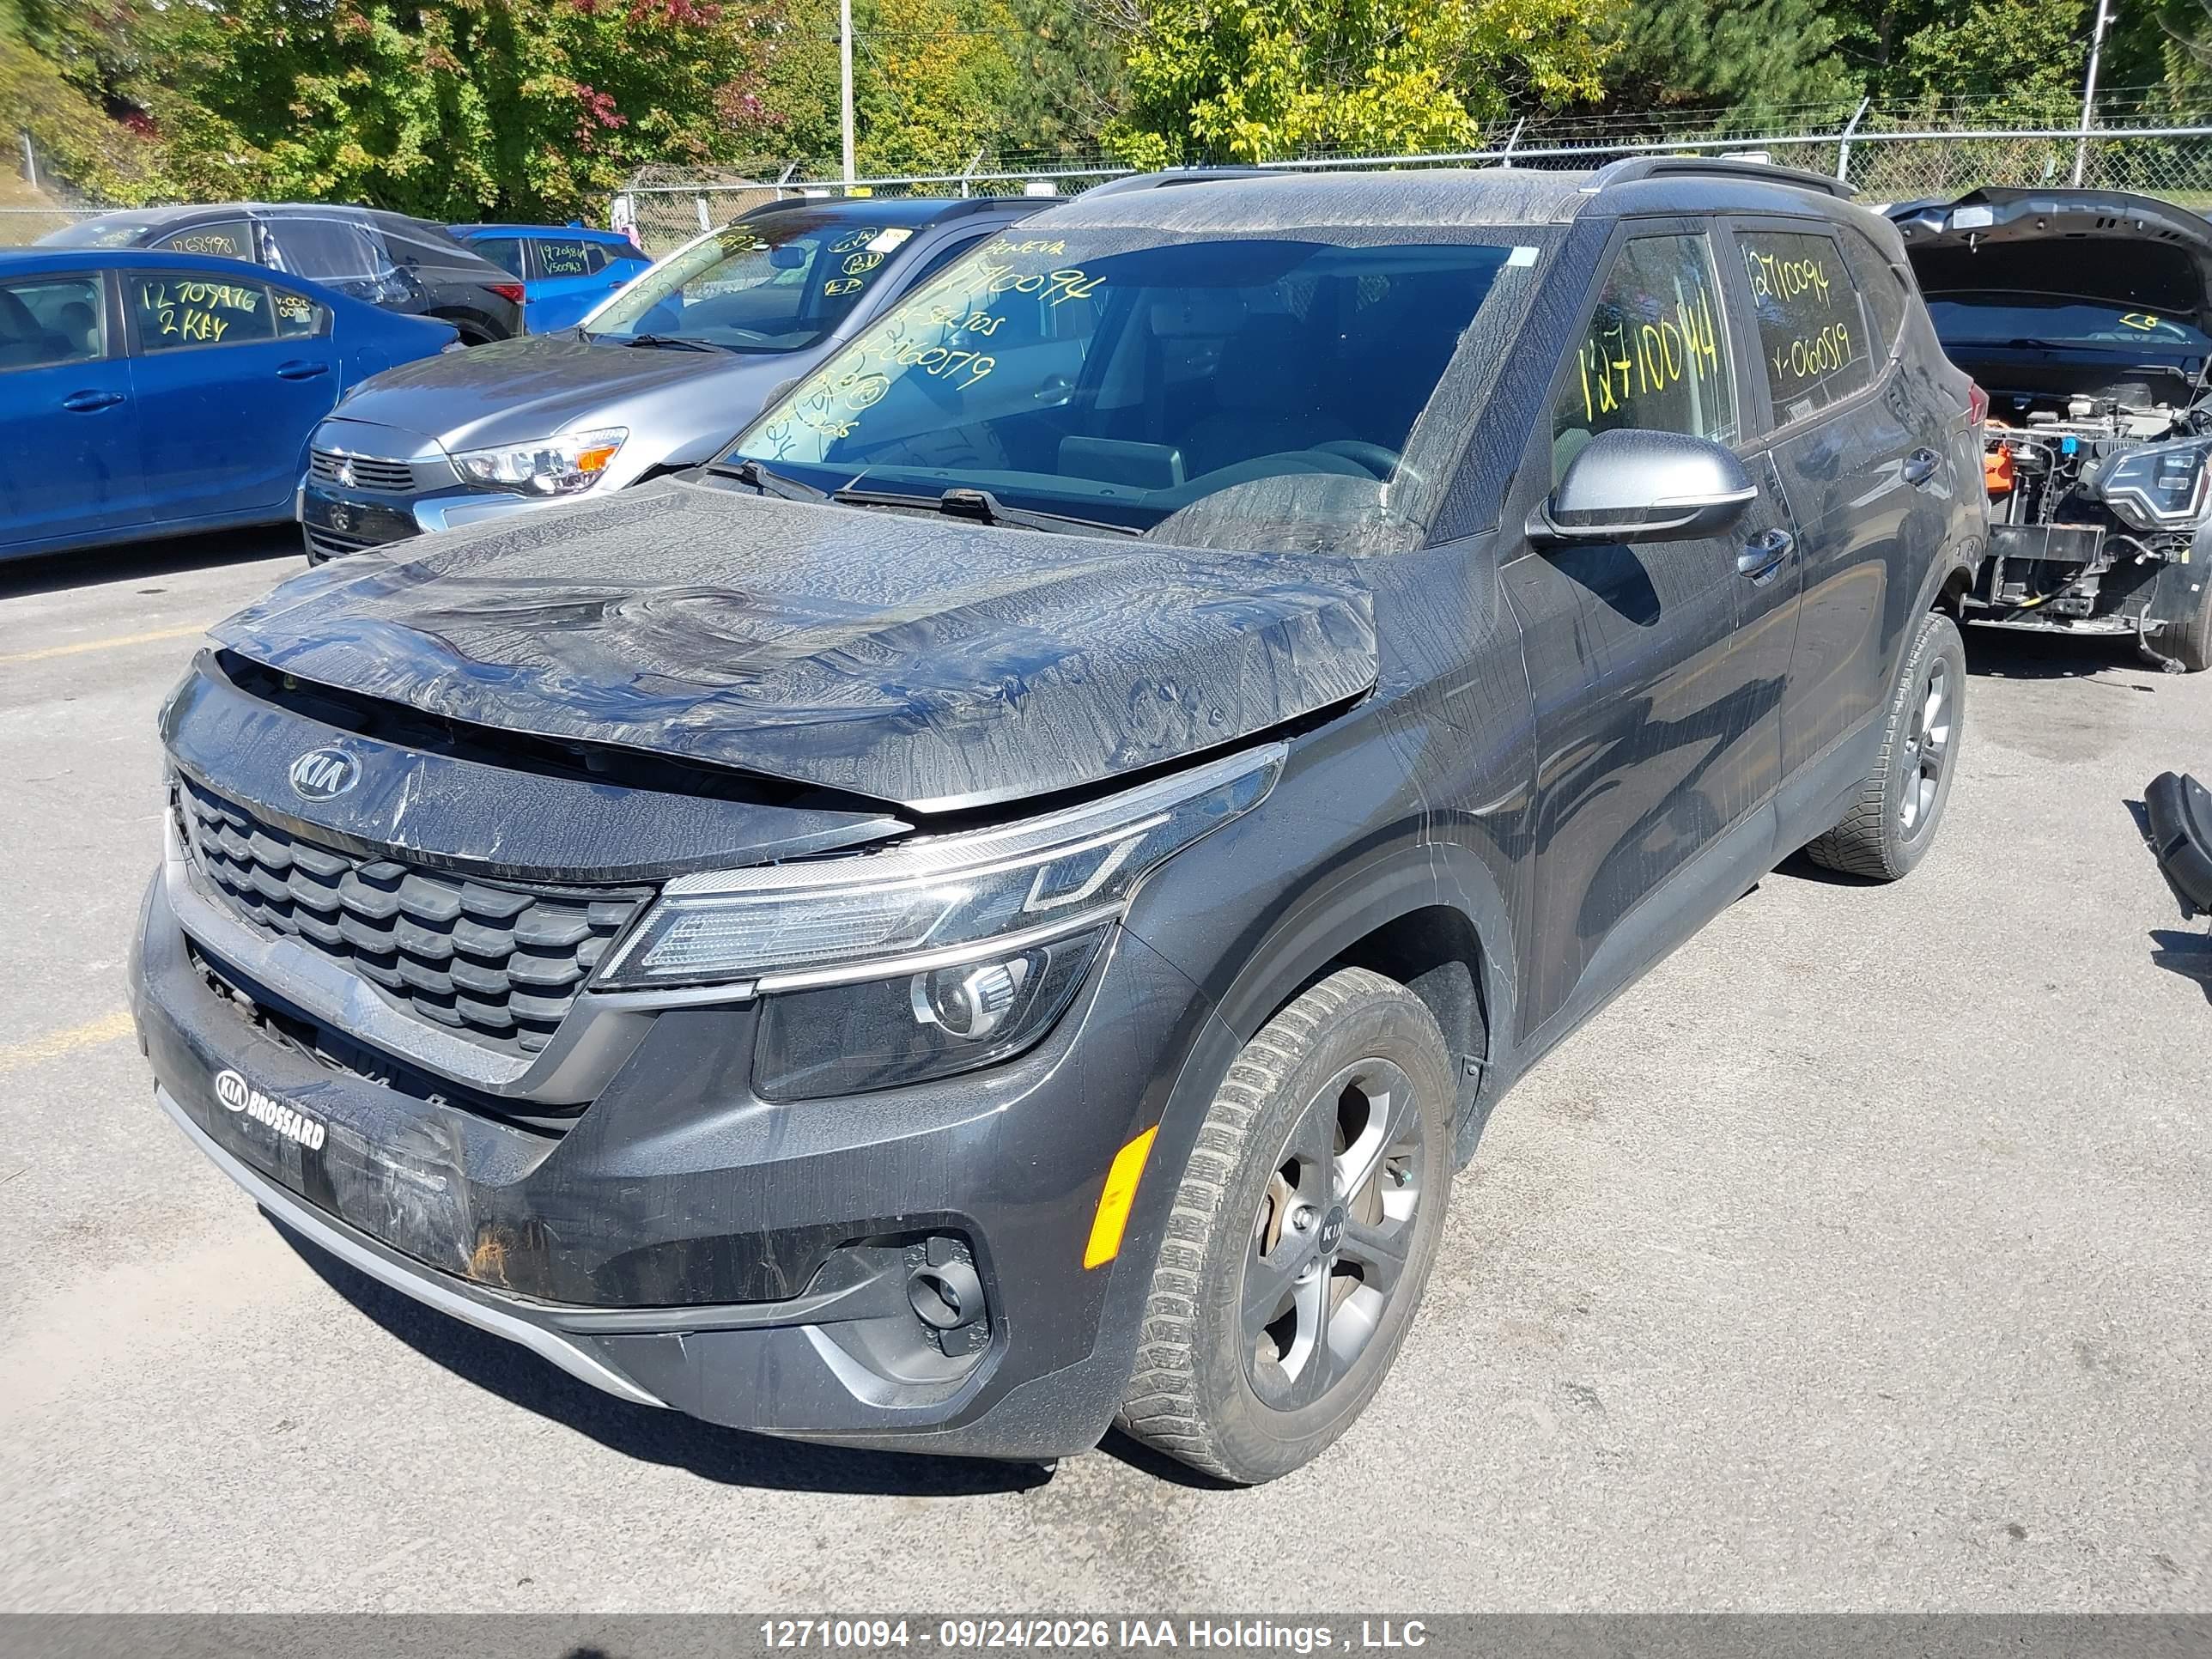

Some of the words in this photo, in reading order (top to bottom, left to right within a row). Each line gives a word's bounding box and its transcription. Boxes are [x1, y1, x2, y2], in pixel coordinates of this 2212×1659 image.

[1741, 245, 1830, 309] 12710094
[160, 309, 179, 335] 2
[294, 753, 345, 793] KIA
[220, 1075, 243, 1107] KIA
[247, 1090, 325, 1151] BROSSARD
[1322, 1222, 1343, 1241] KIA
